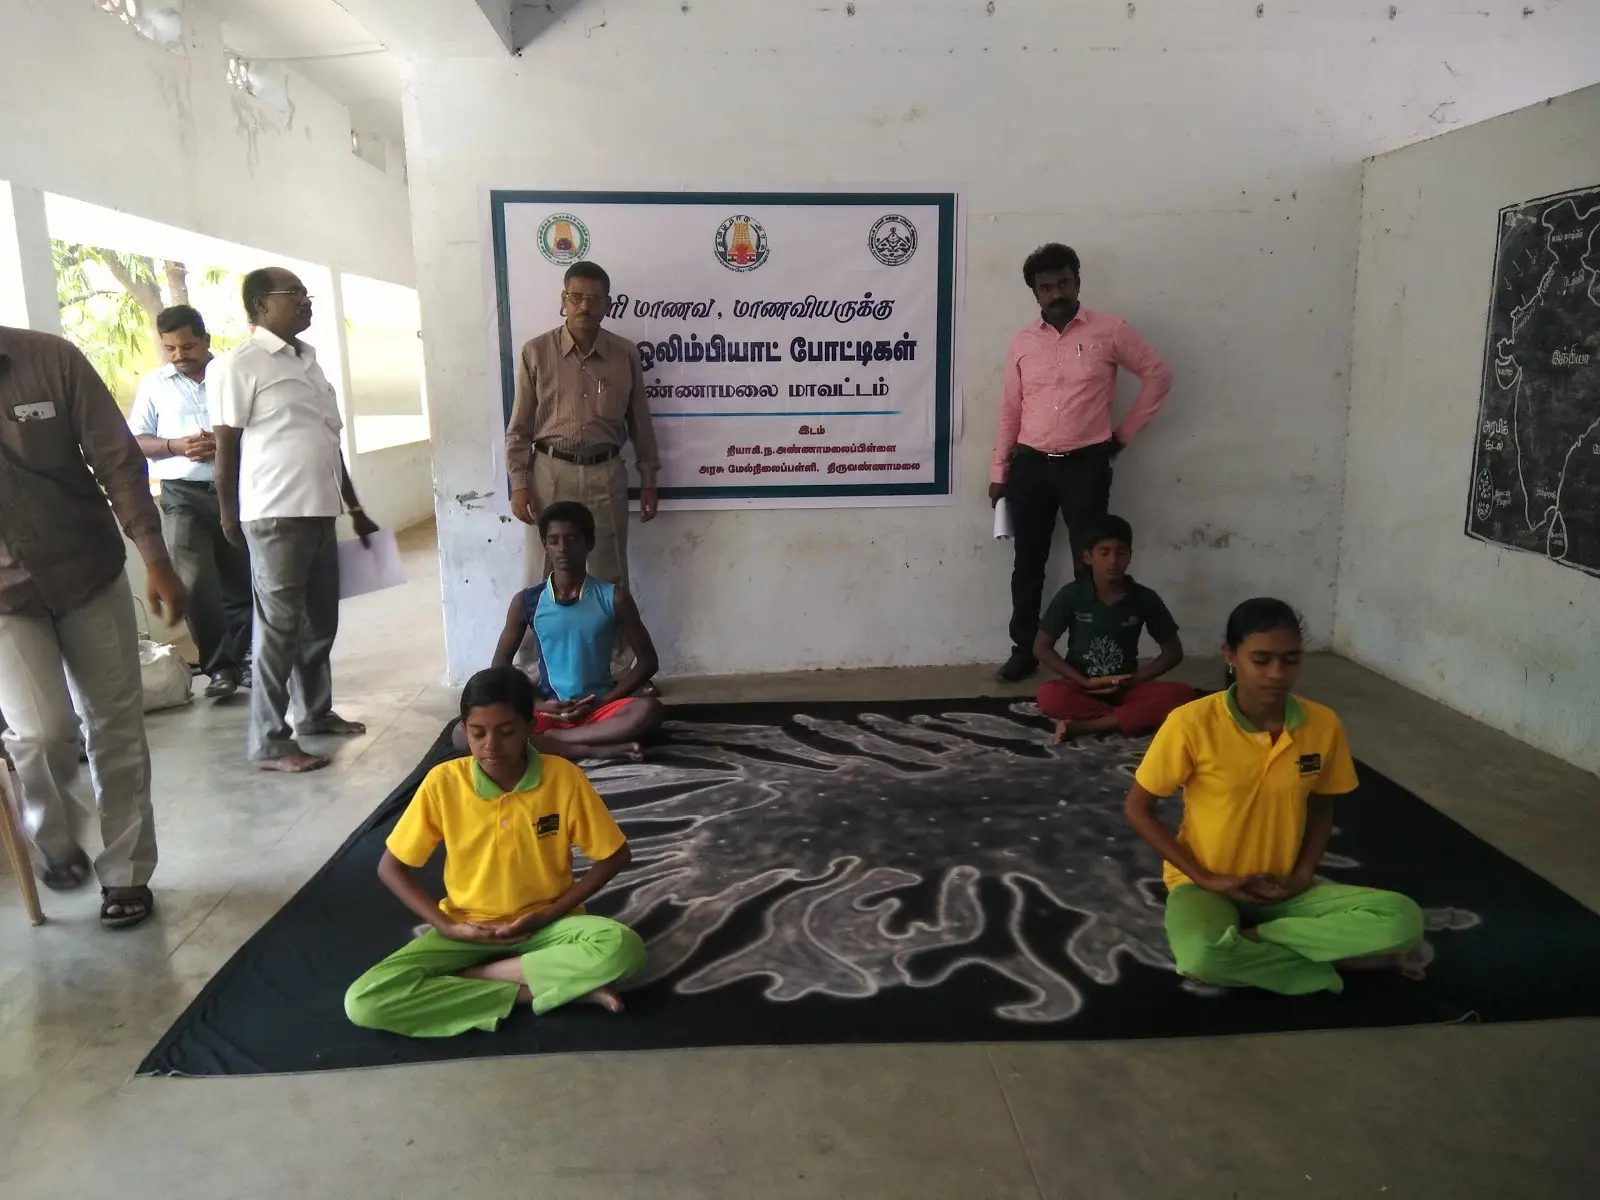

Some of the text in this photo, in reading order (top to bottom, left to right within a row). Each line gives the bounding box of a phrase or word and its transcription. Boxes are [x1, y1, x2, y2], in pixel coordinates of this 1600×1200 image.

[733, 292, 896, 324] மாணவியருக்கு
[790, 331, 917, 367] போட்டிகள்
[645, 376, 890, 399] ண்ணாமலை மாவட்டம்
[798, 425, 826, 435] இடம்
[698, 465, 725, 476] அரசு
[826, 461, 921, 475] திருவண்ணாமலை
